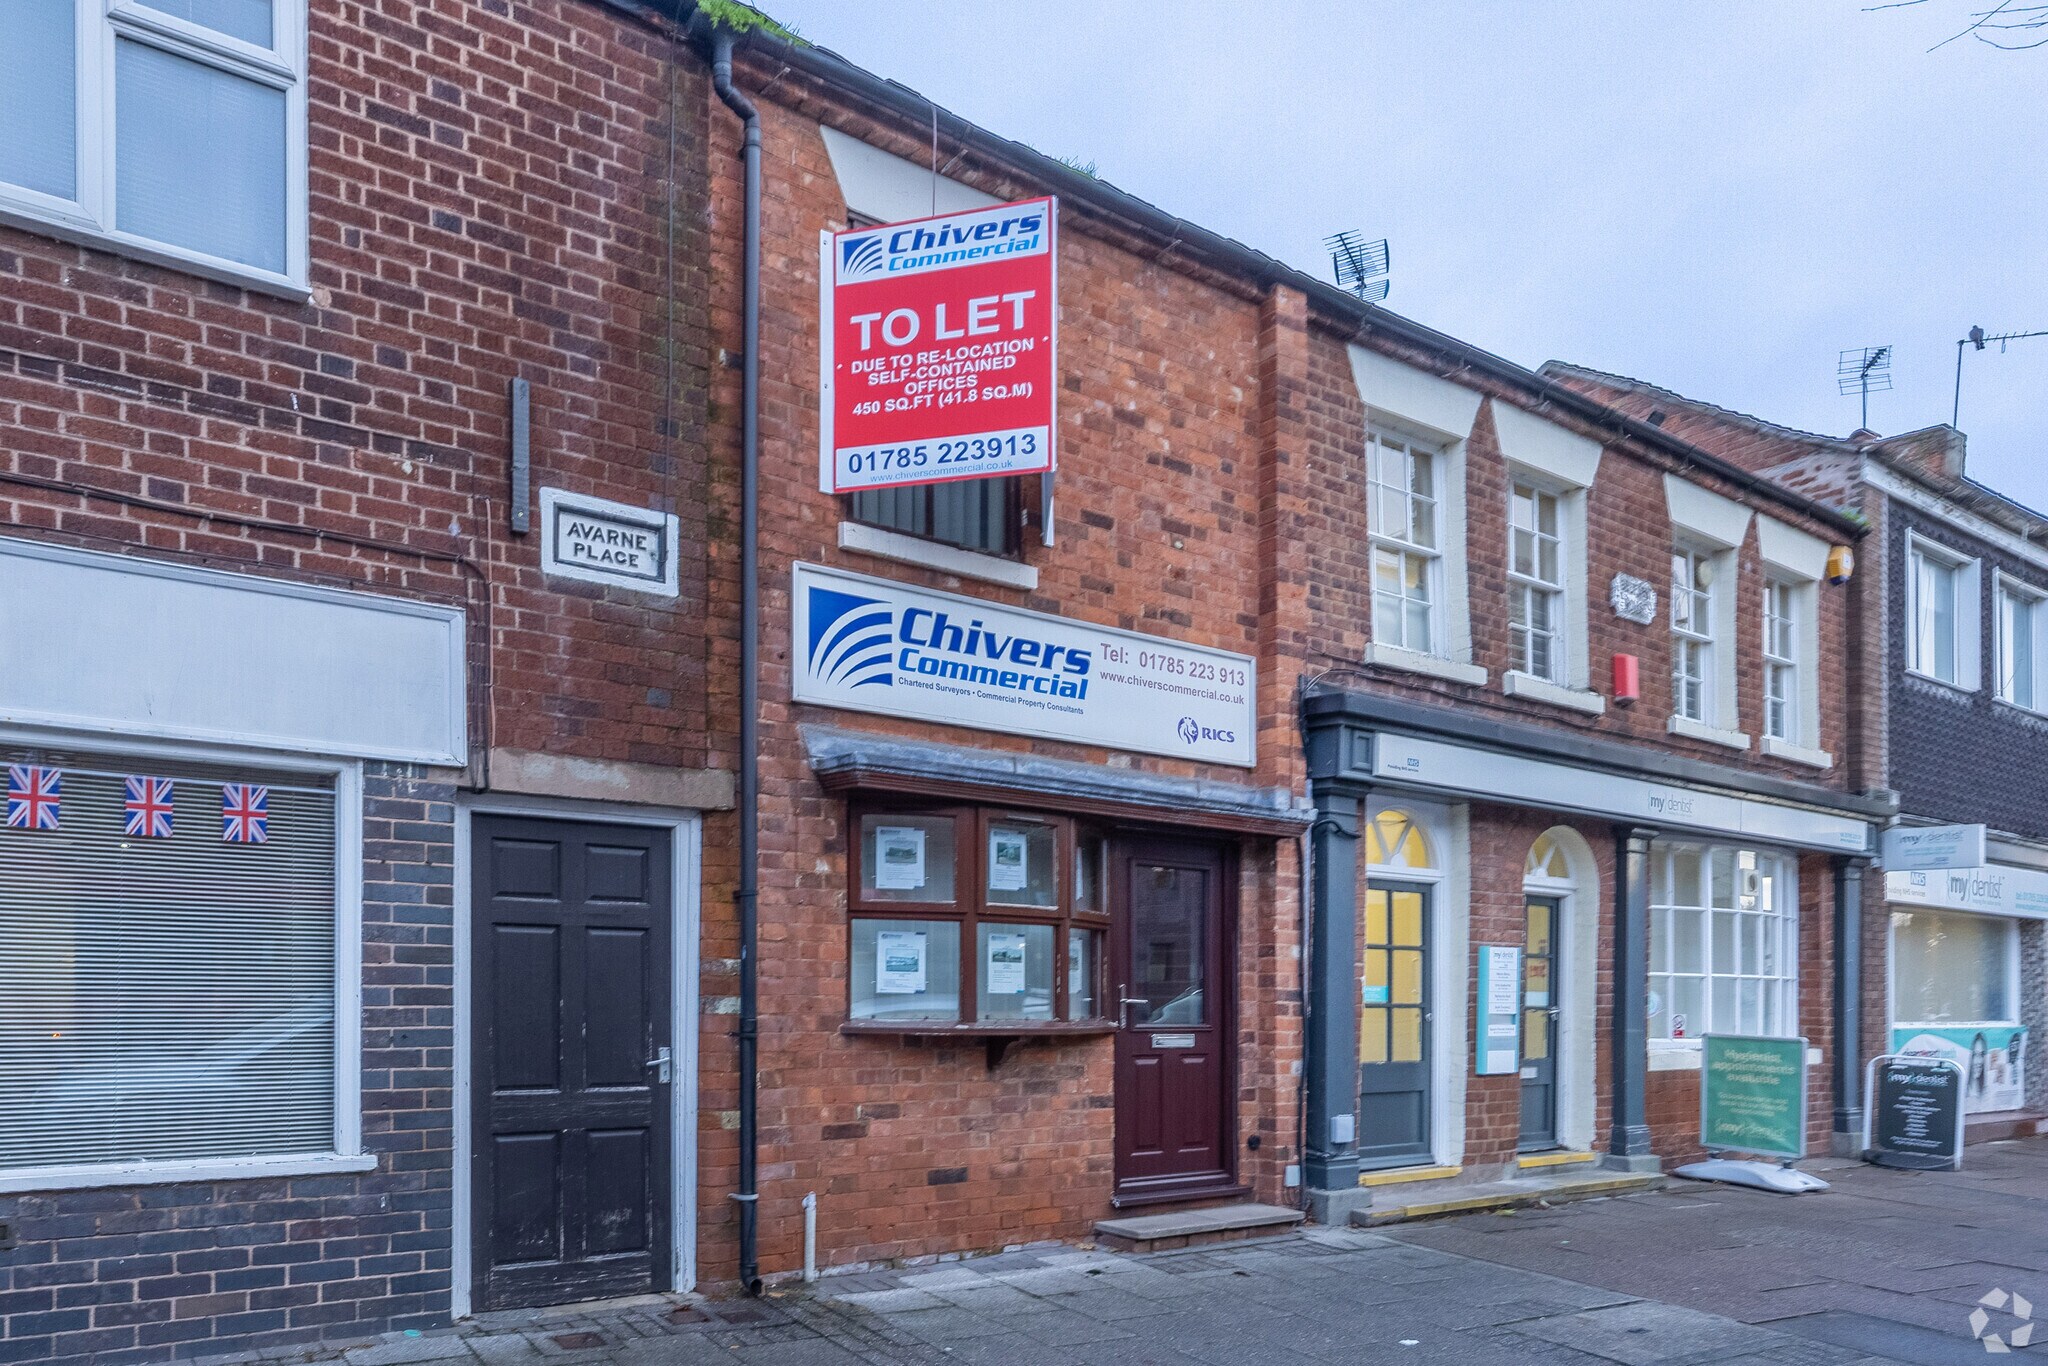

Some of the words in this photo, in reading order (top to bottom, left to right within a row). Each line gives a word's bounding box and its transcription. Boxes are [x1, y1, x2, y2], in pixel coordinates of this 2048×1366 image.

[889, 213, 1043, 254] Chivers
[888, 234, 1039, 272] Commercial
[850, 308, 920, 352] TO
[935, 290, 1036, 341] LET
[852, 357, 886, 374] DUE
[889, 354, 914, 370] TO
[917, 338, 1035, 366] RE-LOCATION
[868, 355, 1016, 387] SELF-CONTAINED
[852, 401, 881, 416] 450
[884, 394, 934, 412] SQ.FT
[938, 389, 978, 410] (41.8
[982, 382, 1033, 401] SQ.M)
[904, 375, 979, 395] OFFICES
[848, 445, 928, 475] 01785
[937, 433, 1037, 465] 223913
[870, 459, 1013, 483] www.chiverscommercial.co.uk
[567, 521, 648, 551] AVARNE
[573, 542, 639, 568] PLACE
[898, 606, 1092, 675] Chivers
[898, 647, 1089, 700] Commercial
[1100, 643, 1129, 664] Tel:
[1139, 651, 1185, 675] 01785
[1189, 661, 1215, 681] 223
[1219, 667, 1245, 687] 913
[898, 677, 934, 690] Chartered
[935, 682, 971, 696] Surveyors
[977, 690, 1017, 704] Commercial
[1018, 696, 1046, 710] Property
[1047, 702, 1084, 715] Consultants
[1100, 671, 1245, 705] www.chiverscommercial.co.uk
[1201, 727, 1235, 743] RICS
